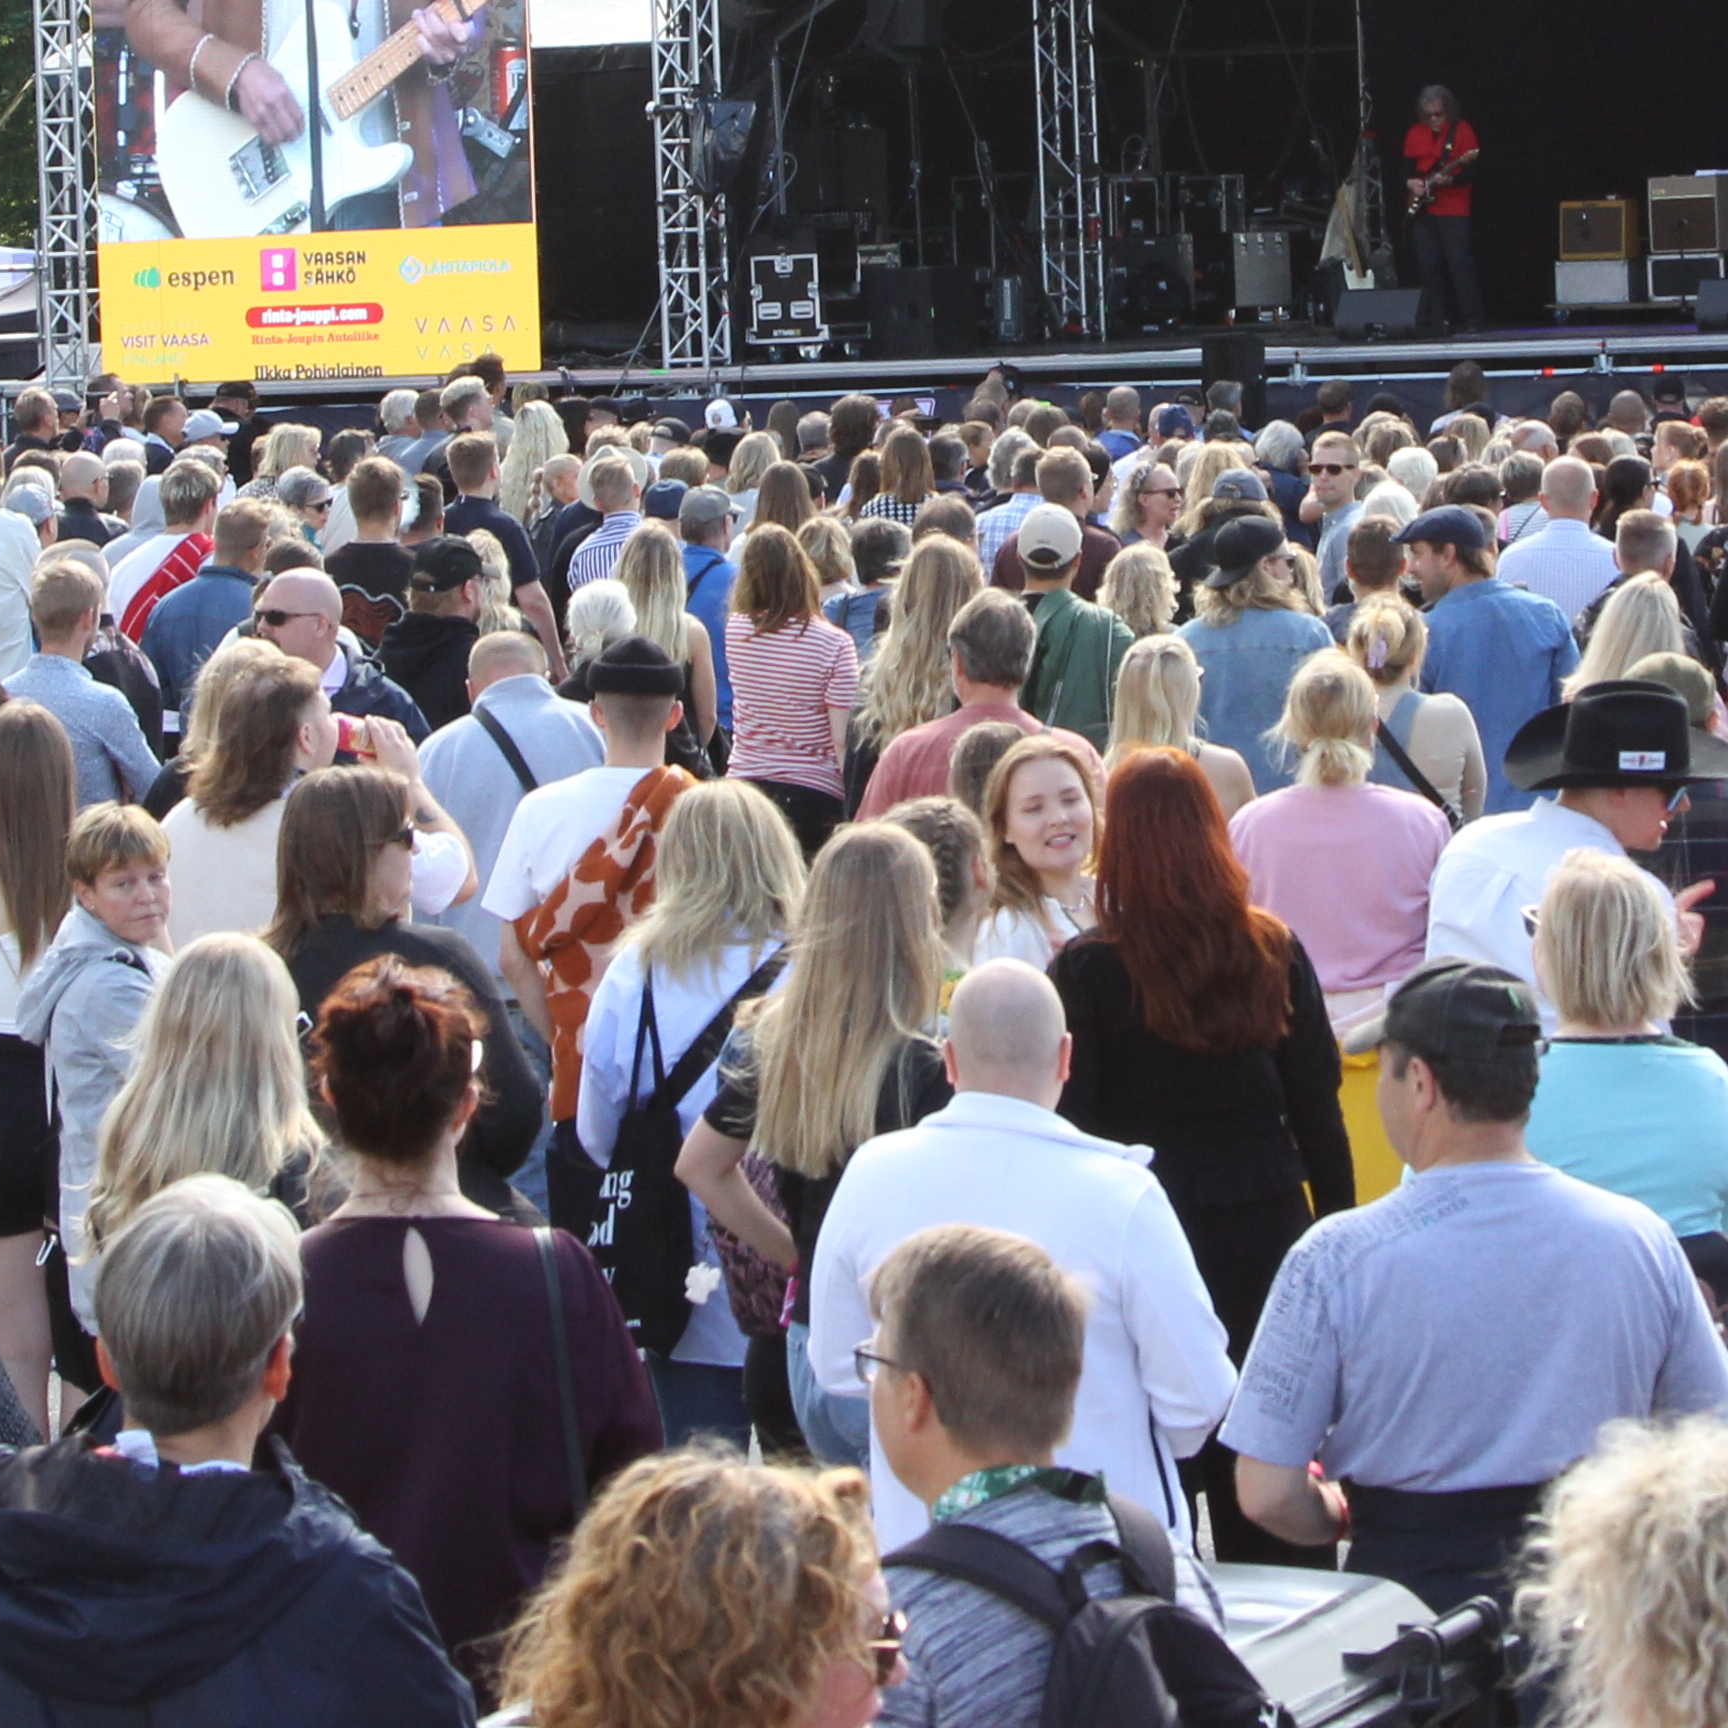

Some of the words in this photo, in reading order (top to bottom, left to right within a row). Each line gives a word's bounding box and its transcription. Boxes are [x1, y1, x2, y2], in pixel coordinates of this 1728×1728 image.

[303, 250, 366, 266] VAASAN
[168, 269, 235, 292] espen
[304, 267, 356, 285] SÄHKÖ
[261, 306, 368, 326] rinta-jouppi.com
[121, 334, 156, 349] VISIT
[161, 333, 210, 347] VAASA
[327, 331, 380, 343] Autoliike
